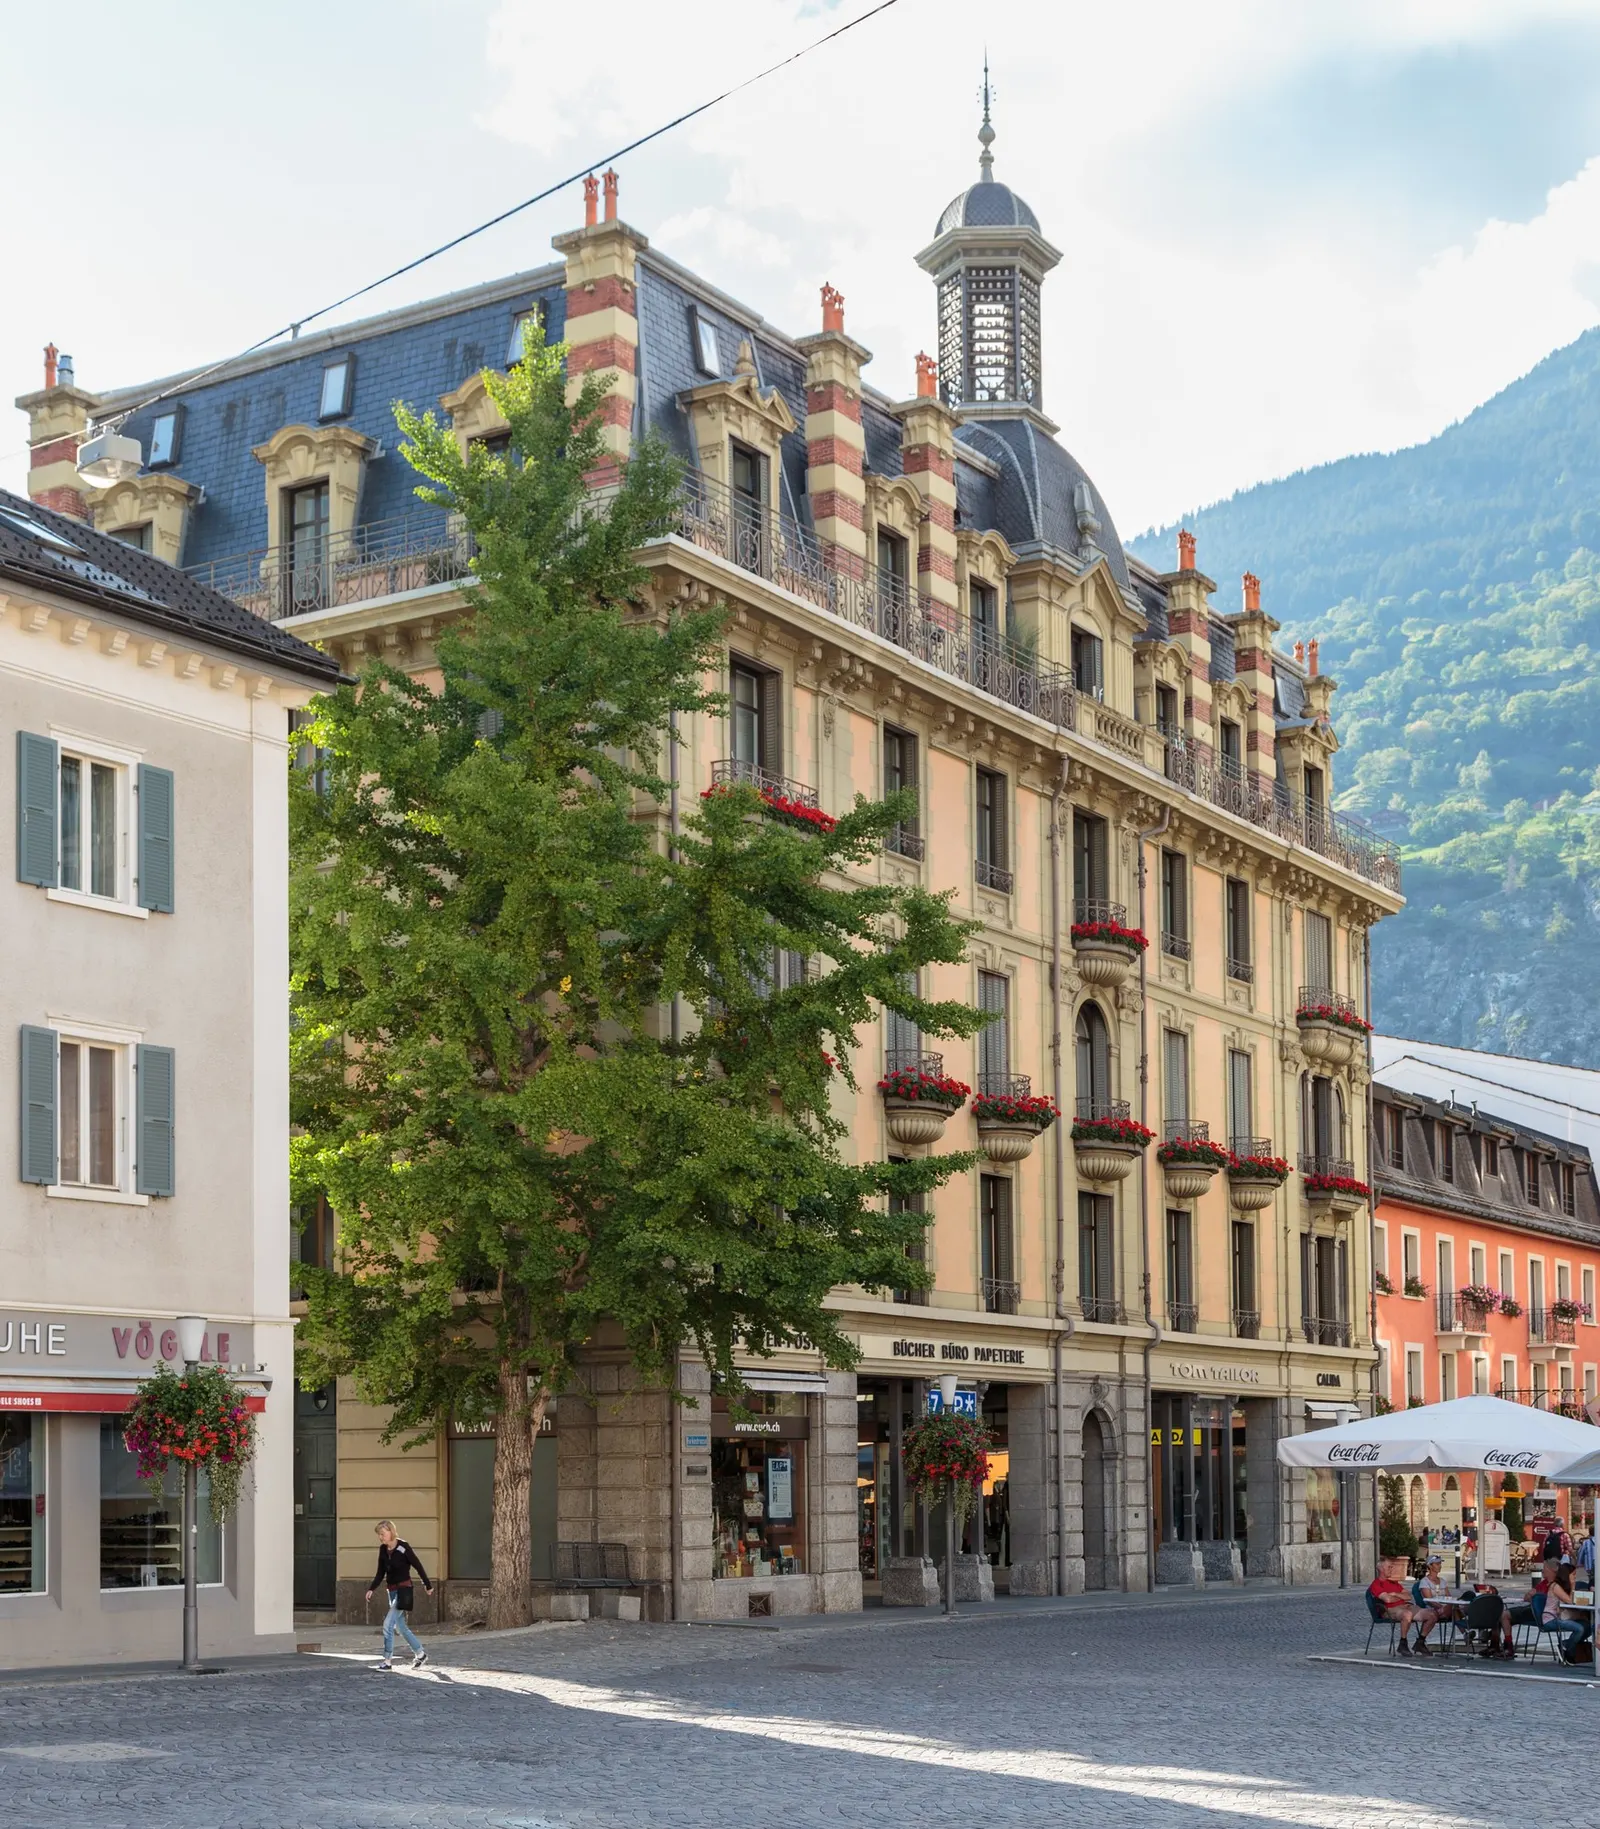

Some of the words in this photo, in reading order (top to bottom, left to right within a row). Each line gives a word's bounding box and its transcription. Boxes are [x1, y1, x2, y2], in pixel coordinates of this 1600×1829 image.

[0, 1321, 67, 1356] UHE
[112, 1320, 230, 1363] VÖGLE
[893, 1339, 935, 1358] BÜCHER
[941, 1342, 969, 1361] BÜRO
[974, 1347, 1025, 1364] PAPETERIE
[1170, 1363, 1207, 1380] TOM
[1210, 1366, 1259, 1383] TAILOR
[13, 1397, 35, 1406] SHOES
[1328, 1443, 1382, 1462] Coca-Cola
[1484, 1449, 1541, 1469] Coca-Cola
